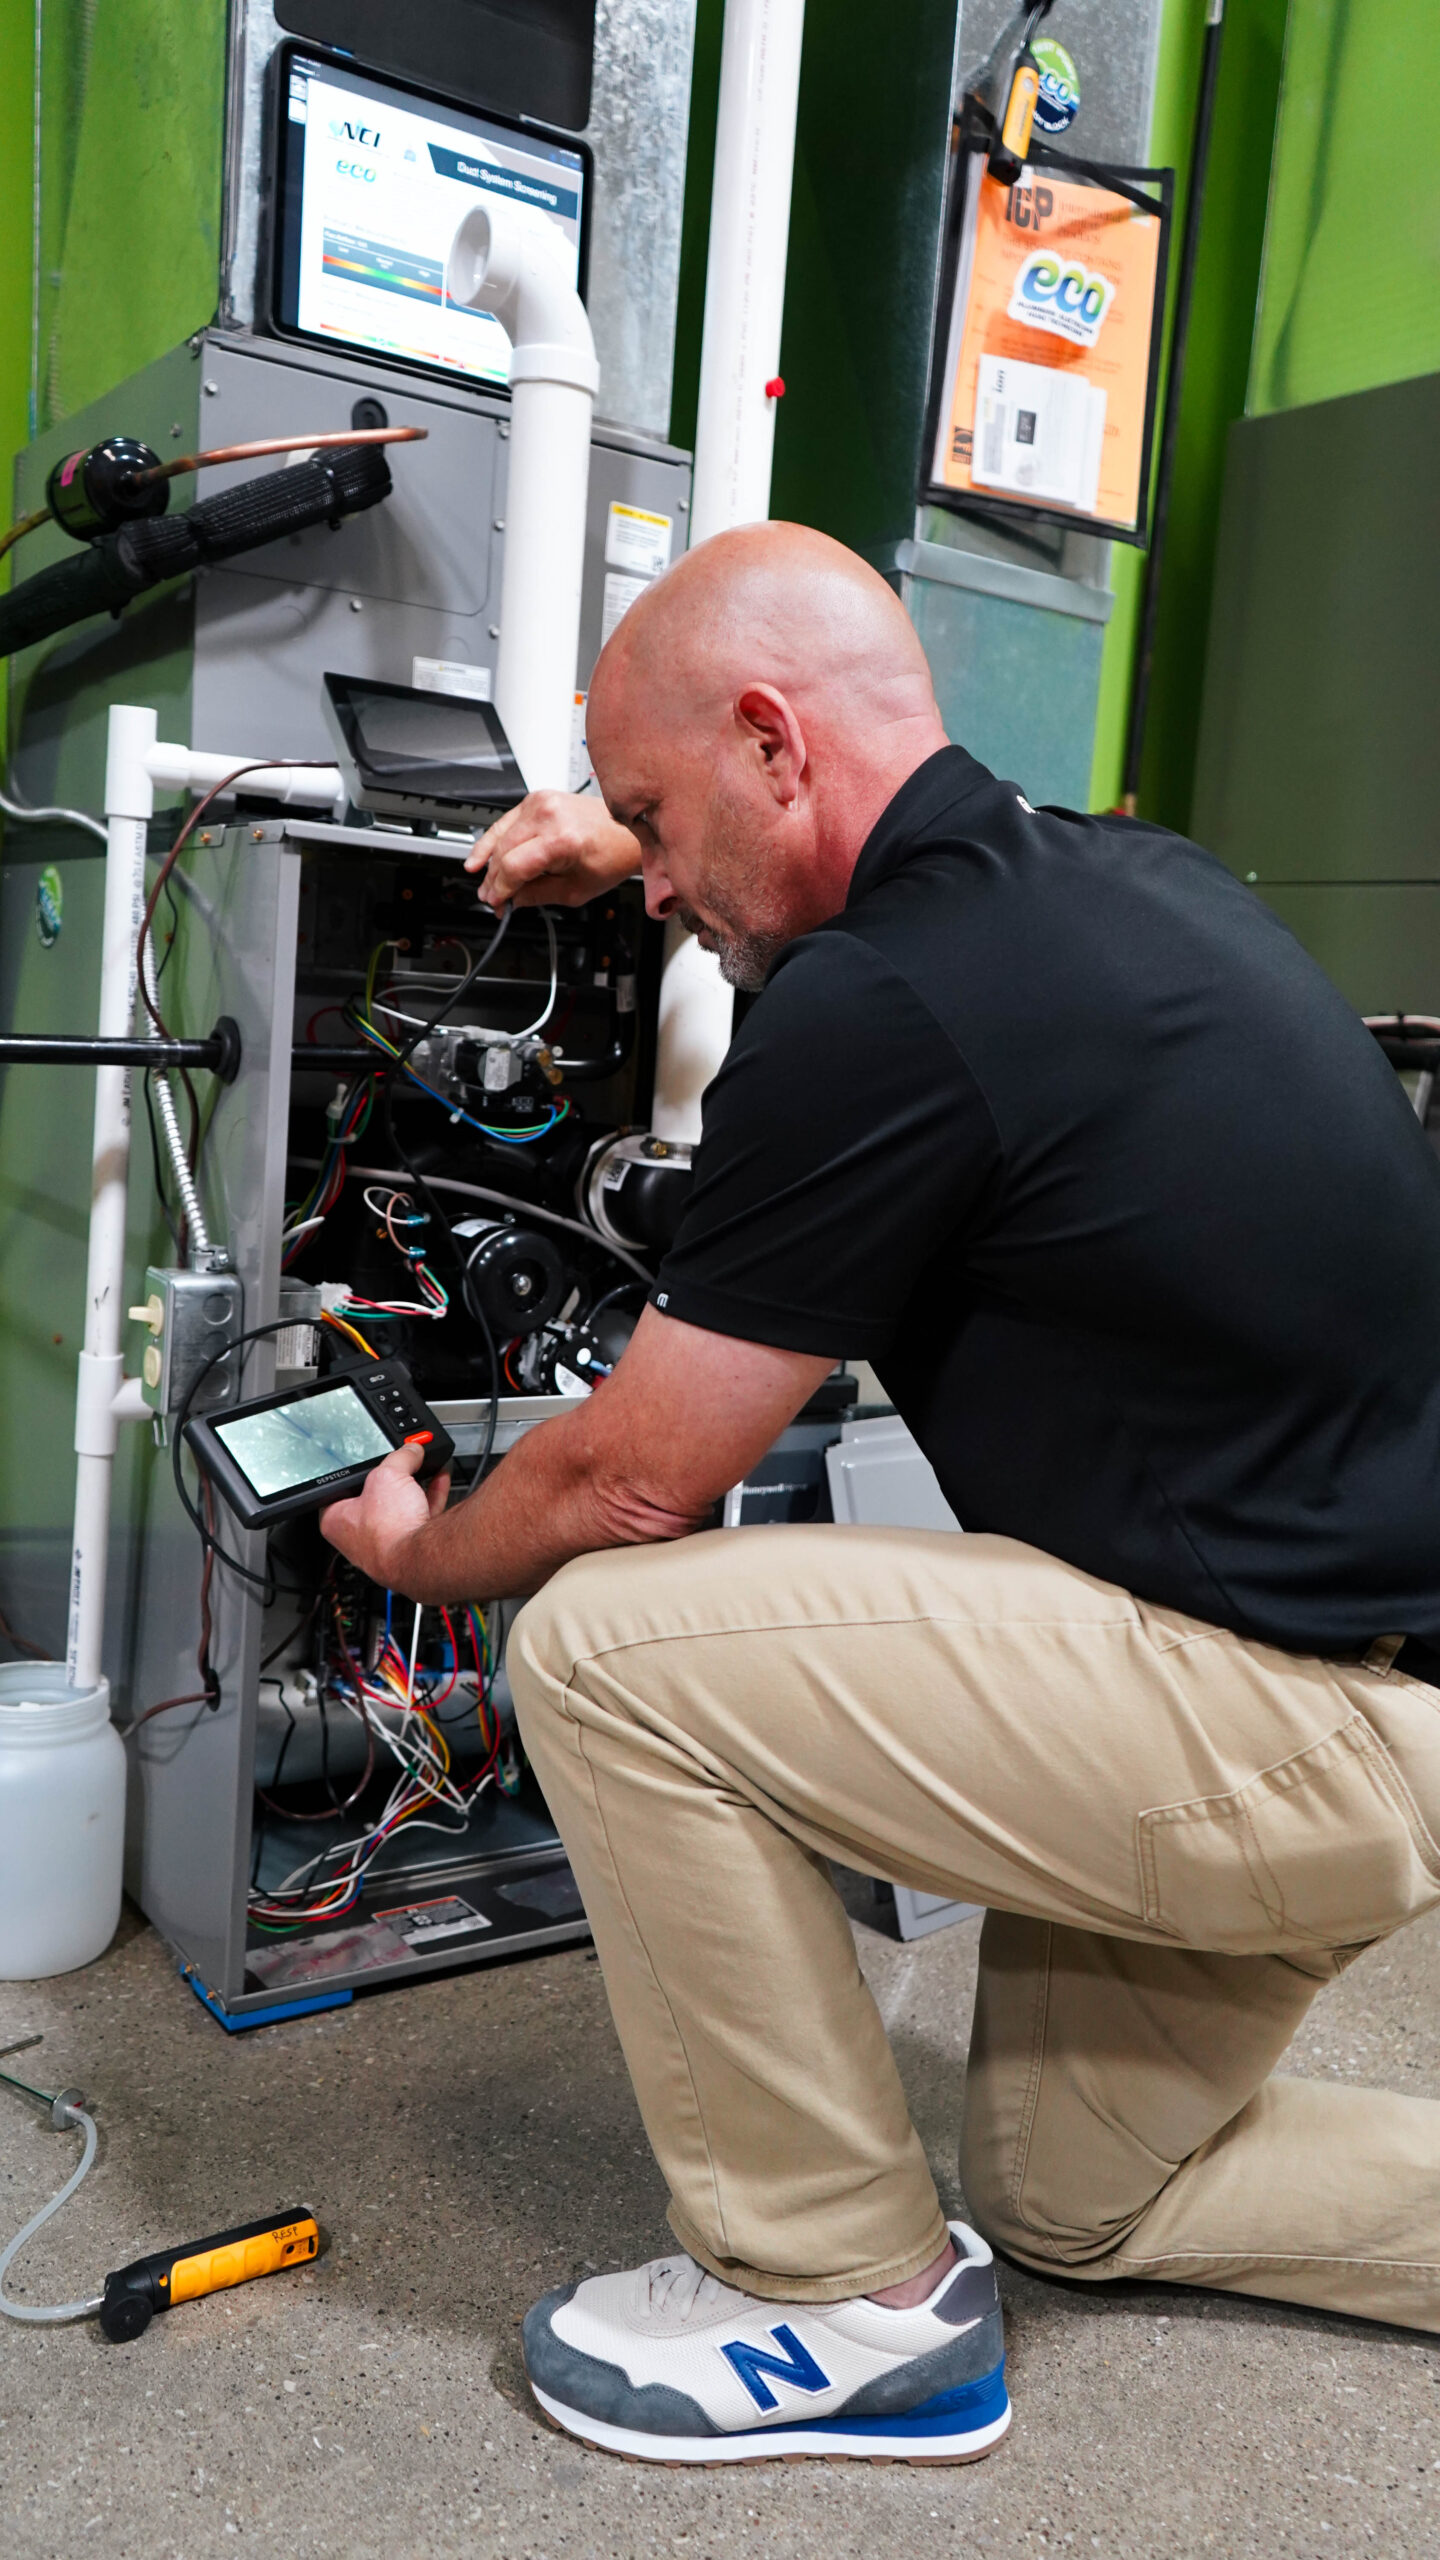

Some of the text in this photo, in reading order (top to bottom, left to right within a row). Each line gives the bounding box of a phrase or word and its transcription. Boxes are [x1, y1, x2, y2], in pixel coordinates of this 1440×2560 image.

[336, 160, 377, 183] eco
[456, 161, 557, 206] Duct System Screening
[1022, 259, 1105, 323] eco
[134, 832, 144, 858] ASTM
[316, 1469, 351, 1485] DEPSTECH
[718, 2322, 834, 2414] N
